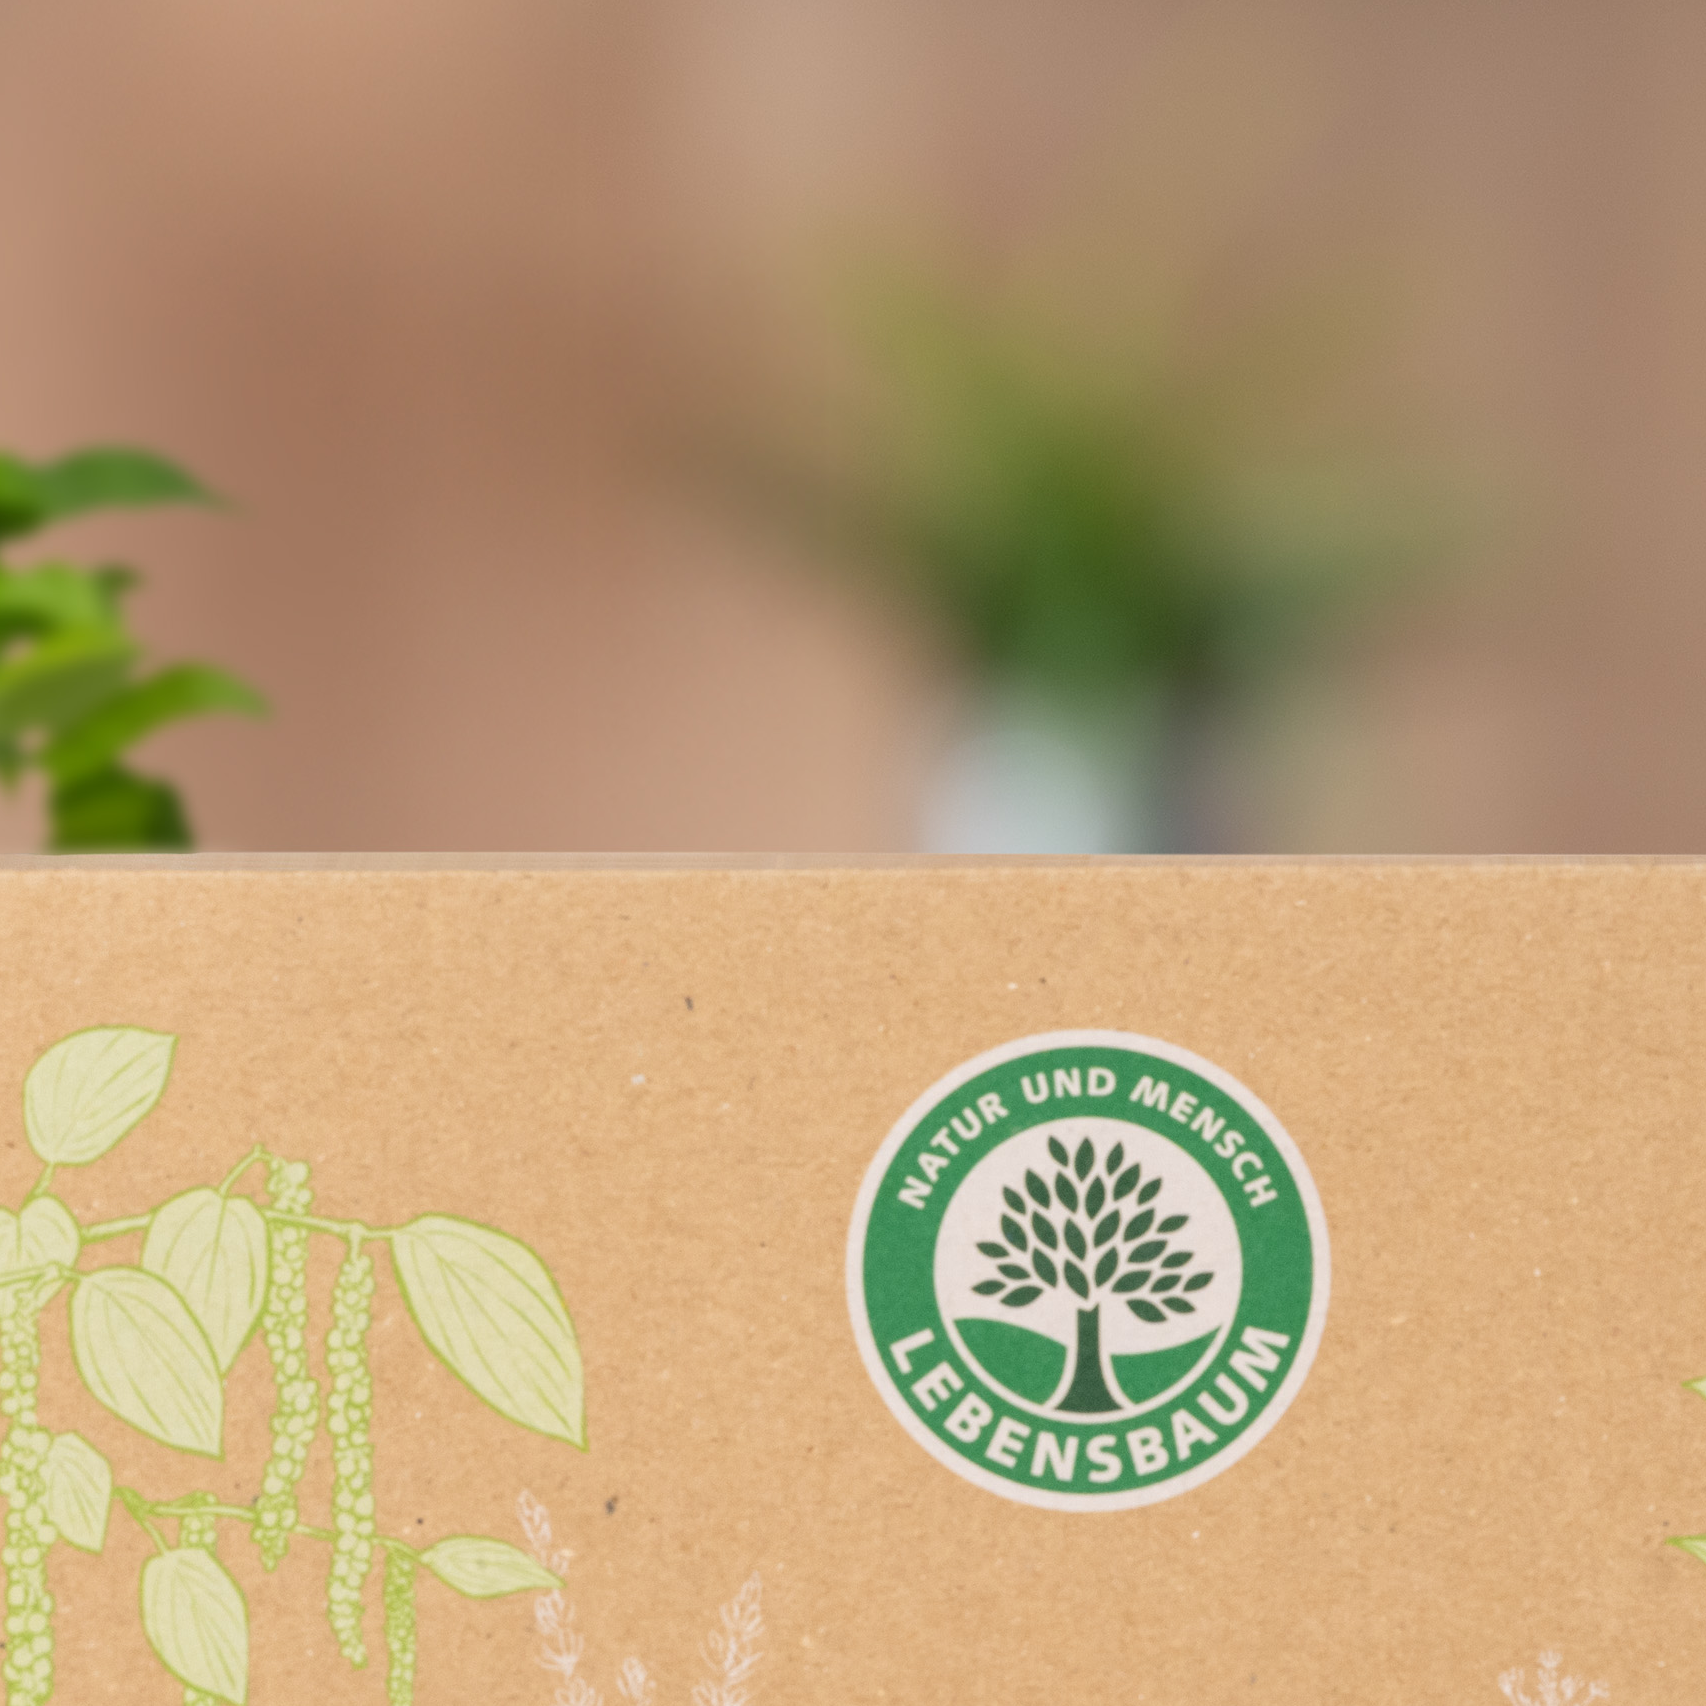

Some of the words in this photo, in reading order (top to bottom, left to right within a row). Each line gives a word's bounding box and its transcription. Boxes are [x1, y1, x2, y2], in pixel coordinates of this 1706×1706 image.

[897, 1092, 1009, 1209] NATUR
[1021, 1067, 1116, 1105] UND
[1130, 1076, 1278, 1207] MENSCH
[890, 1325, 1291, 1483] LEBENSBAUM
